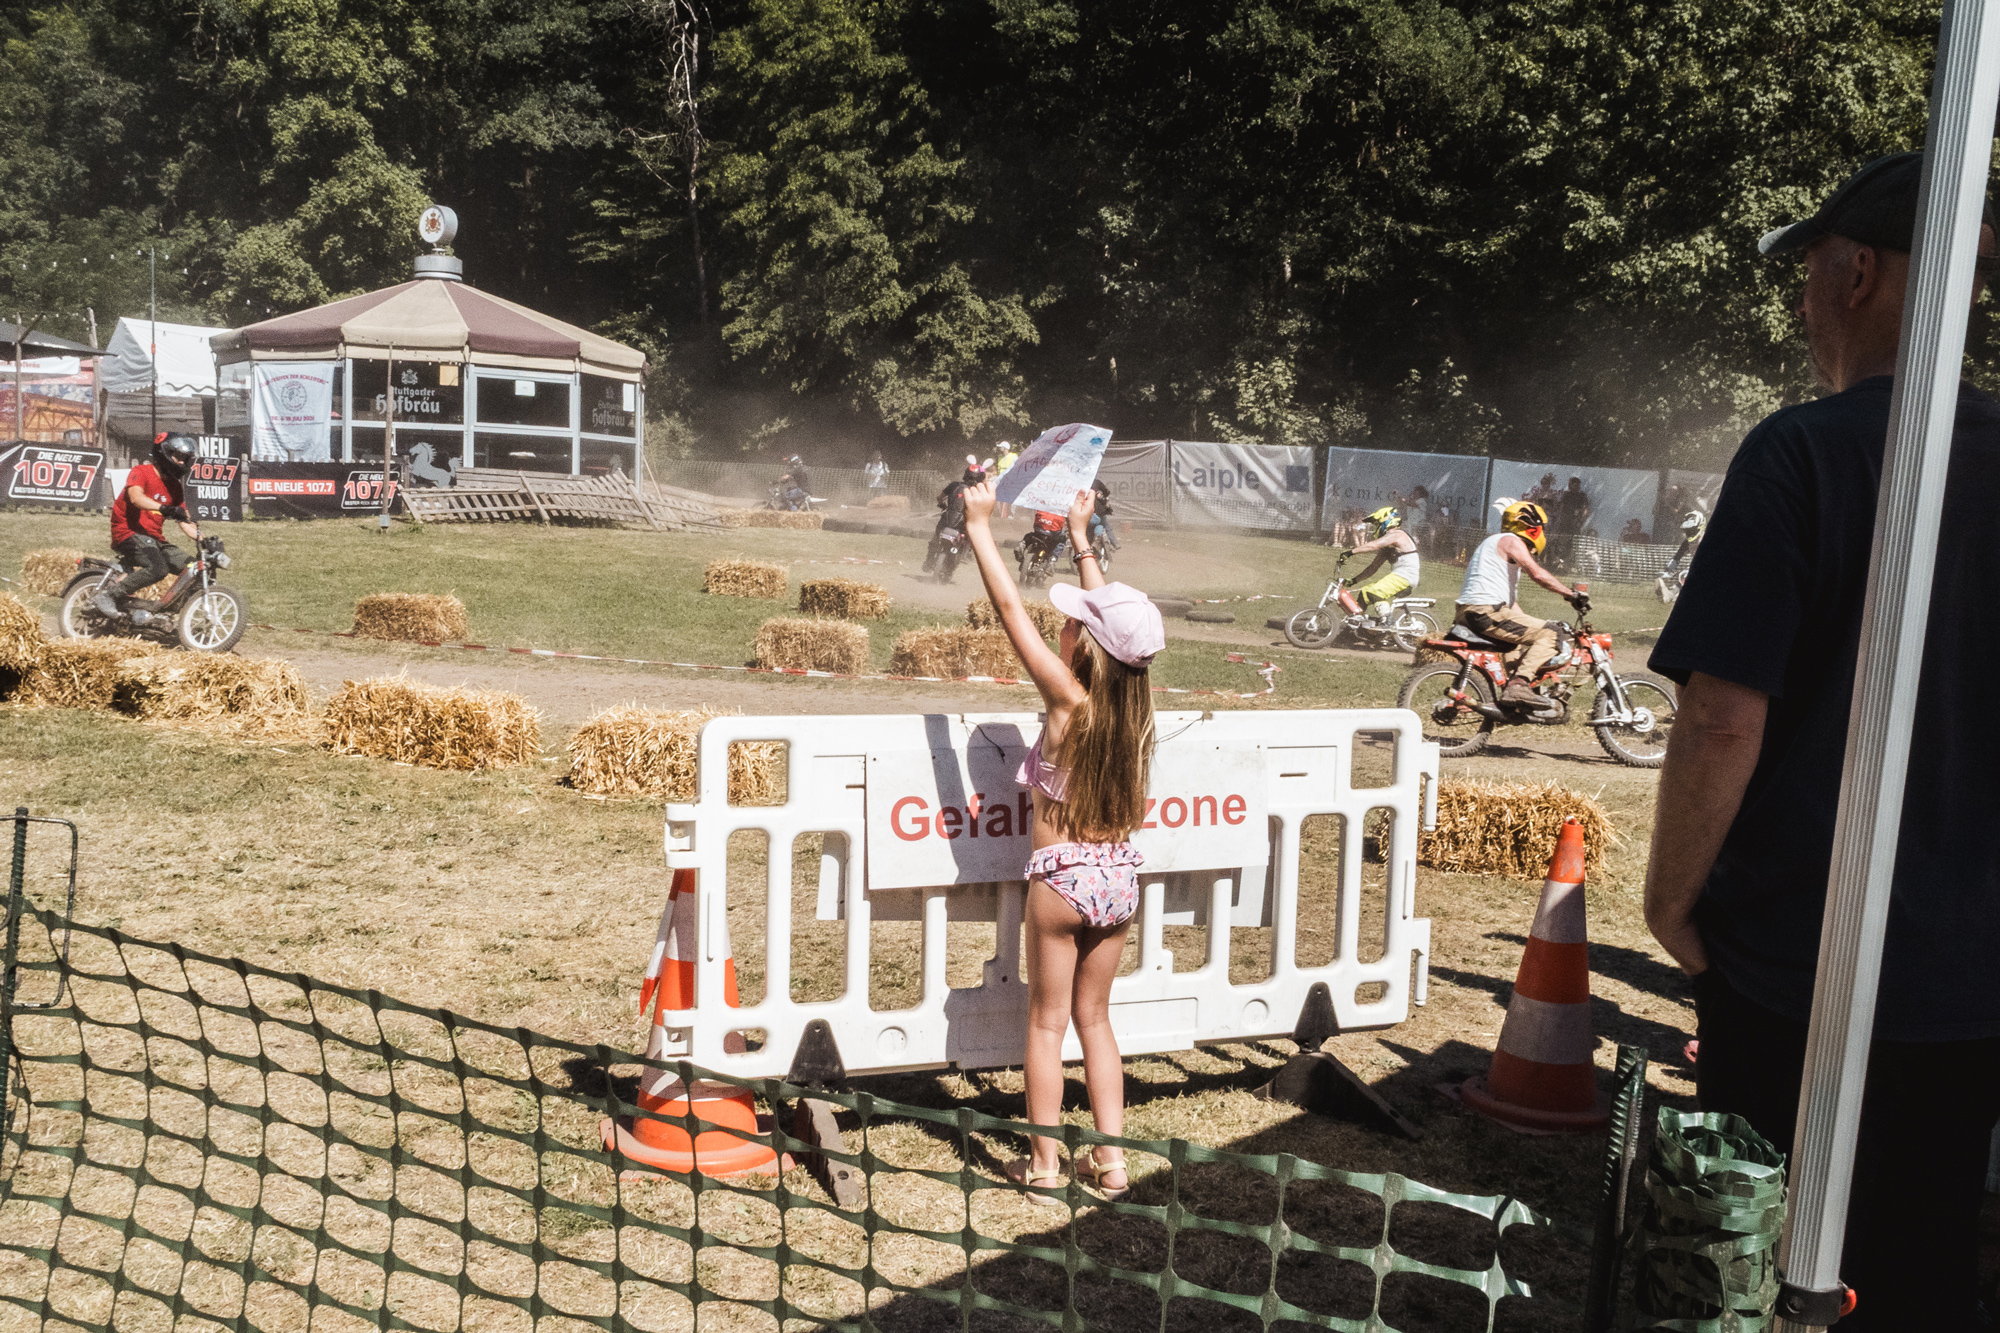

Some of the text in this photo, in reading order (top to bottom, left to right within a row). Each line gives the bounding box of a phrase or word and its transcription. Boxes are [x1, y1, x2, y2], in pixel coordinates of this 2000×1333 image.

[392, 387, 436, 398] tuttgarter
[198, 436, 230, 459] NEU
[37, 451, 83, 463] DIE NEUE
[13, 460, 97, 490] 107.7
[190, 463, 237, 480] 107.7
[1174, 460, 1260, 494] Laiple
[36, 487, 55, 496] ROCK
[197, 486, 229, 500] RADIO
[253, 481, 333, 493] DIE NEUE 107.7
[890, 793, 1247, 841] Gefahzone
